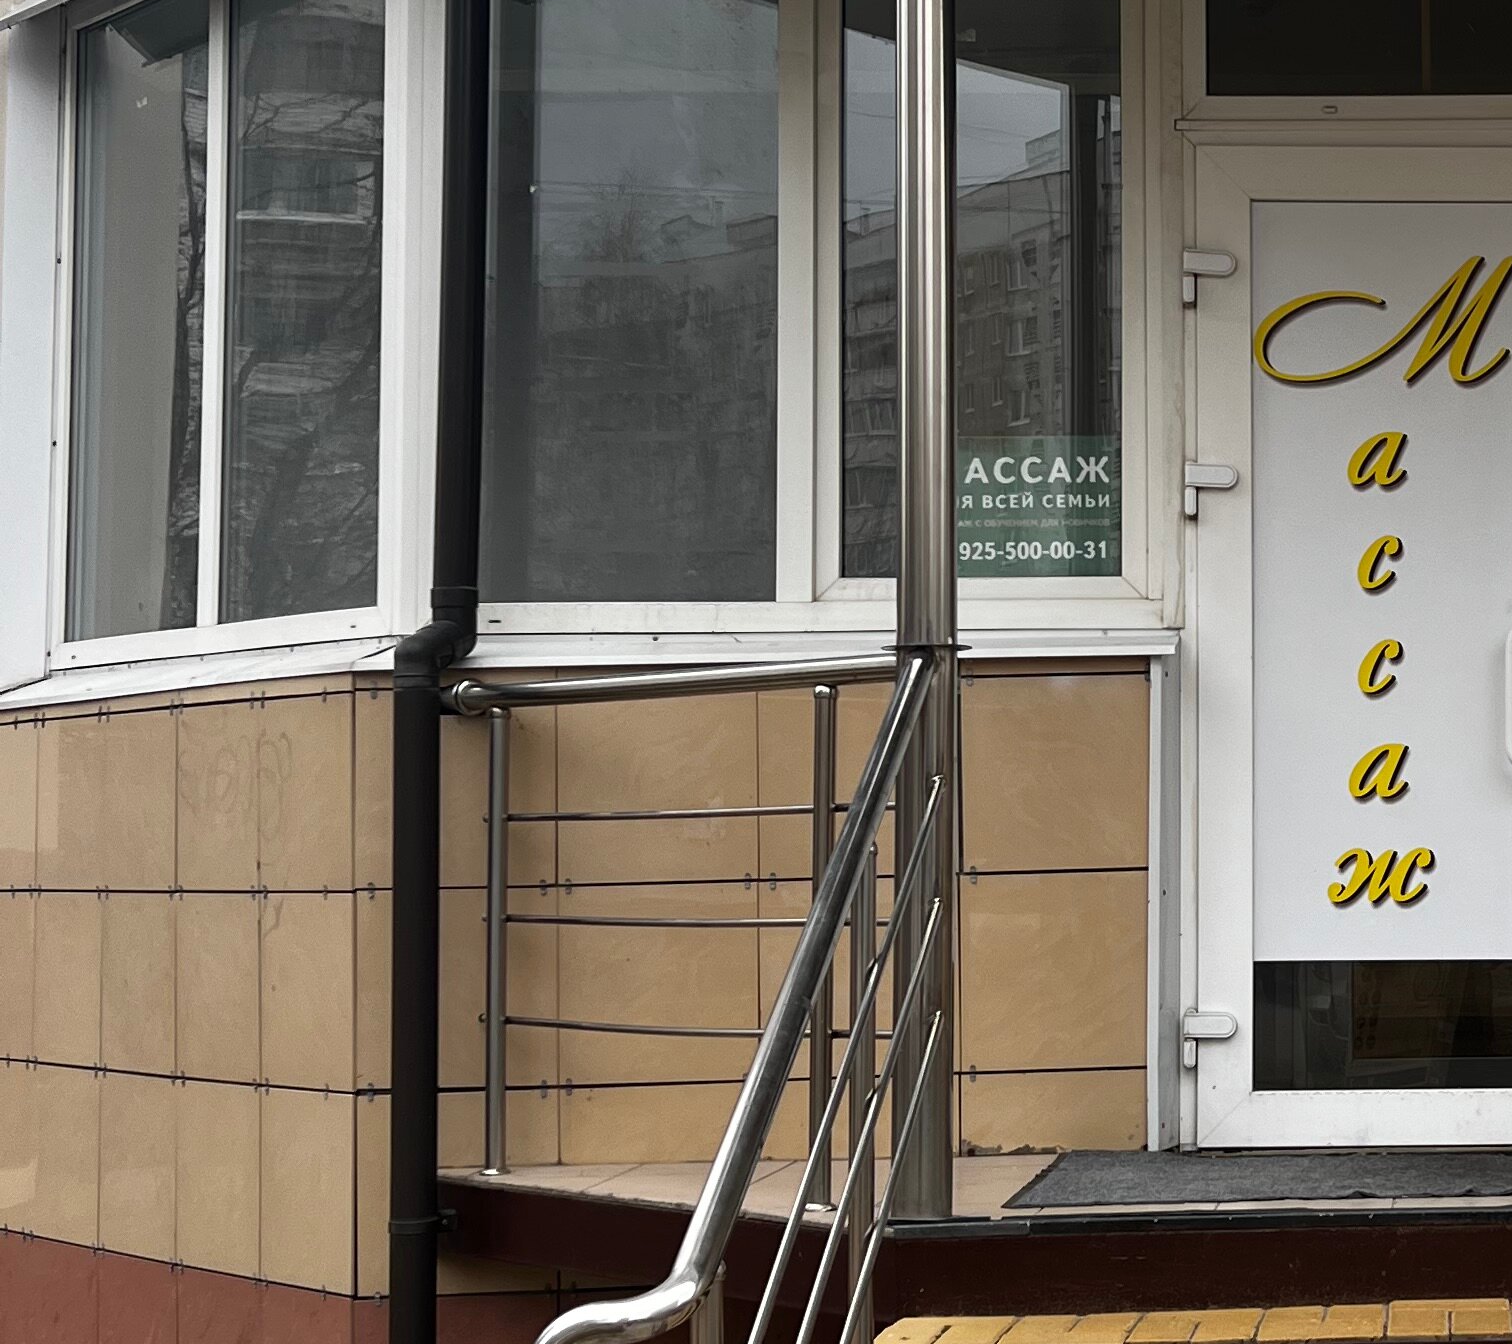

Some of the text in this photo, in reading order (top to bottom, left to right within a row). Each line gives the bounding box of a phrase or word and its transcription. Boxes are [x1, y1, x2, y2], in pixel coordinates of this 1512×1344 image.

[963, 456, 1110, 484] АССАЖ
[957, 491, 1110, 509] Я ВСЕЙ СЕМЬИ
